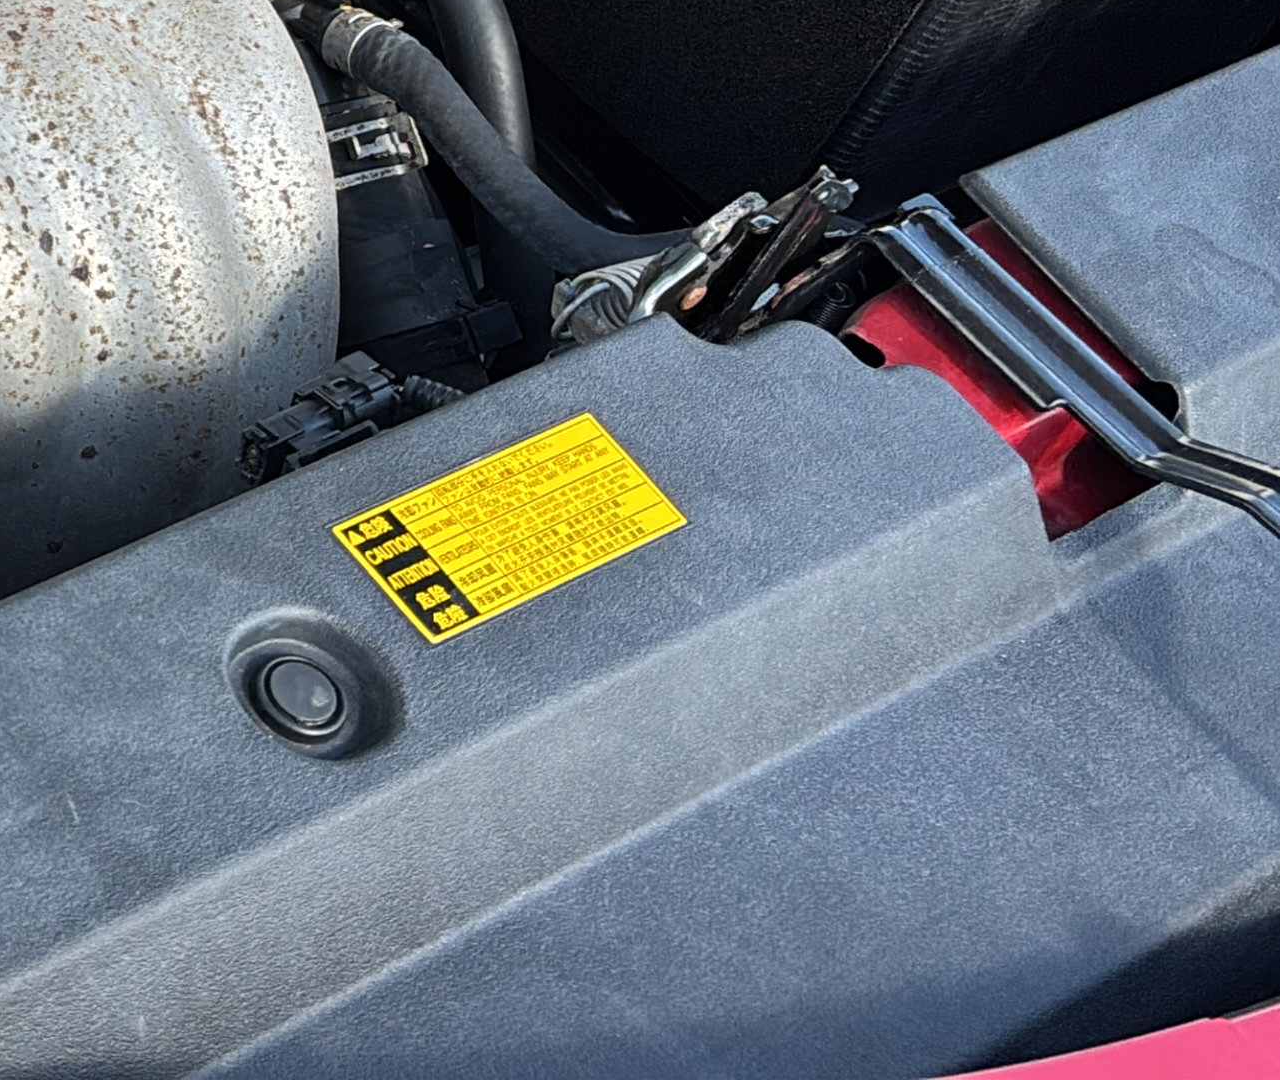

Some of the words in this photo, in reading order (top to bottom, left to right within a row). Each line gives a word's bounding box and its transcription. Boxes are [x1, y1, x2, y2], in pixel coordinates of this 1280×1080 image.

[449, 503, 465, 514] TO
[462, 493, 487, 508] AVOID
[549, 453, 572, 467] KEEP
[570, 442, 597, 458] HANDS
[456, 507, 479, 521] AWAY
[477, 496, 503, 511] FROM
[522, 477, 544, 491] FANS
[542, 469, 561, 481] MAY
[558, 458, 584, 474] START
[582, 453, 595, 463] AT
[592, 446, 611, 458] ANY
[356, 514, 393, 539] 危険
[413, 522, 443, 540] COOLING
[438, 515, 457, 529] FANS
[462, 515, 483, 528] TIME
[481, 499, 516, 519] IGNITION
[362, 532, 419, 566] CAUTION
[384, 557, 440, 591] ATTENTION
[411, 582, 452, 610] 危险
[429, 602, 470, 630] 危險
